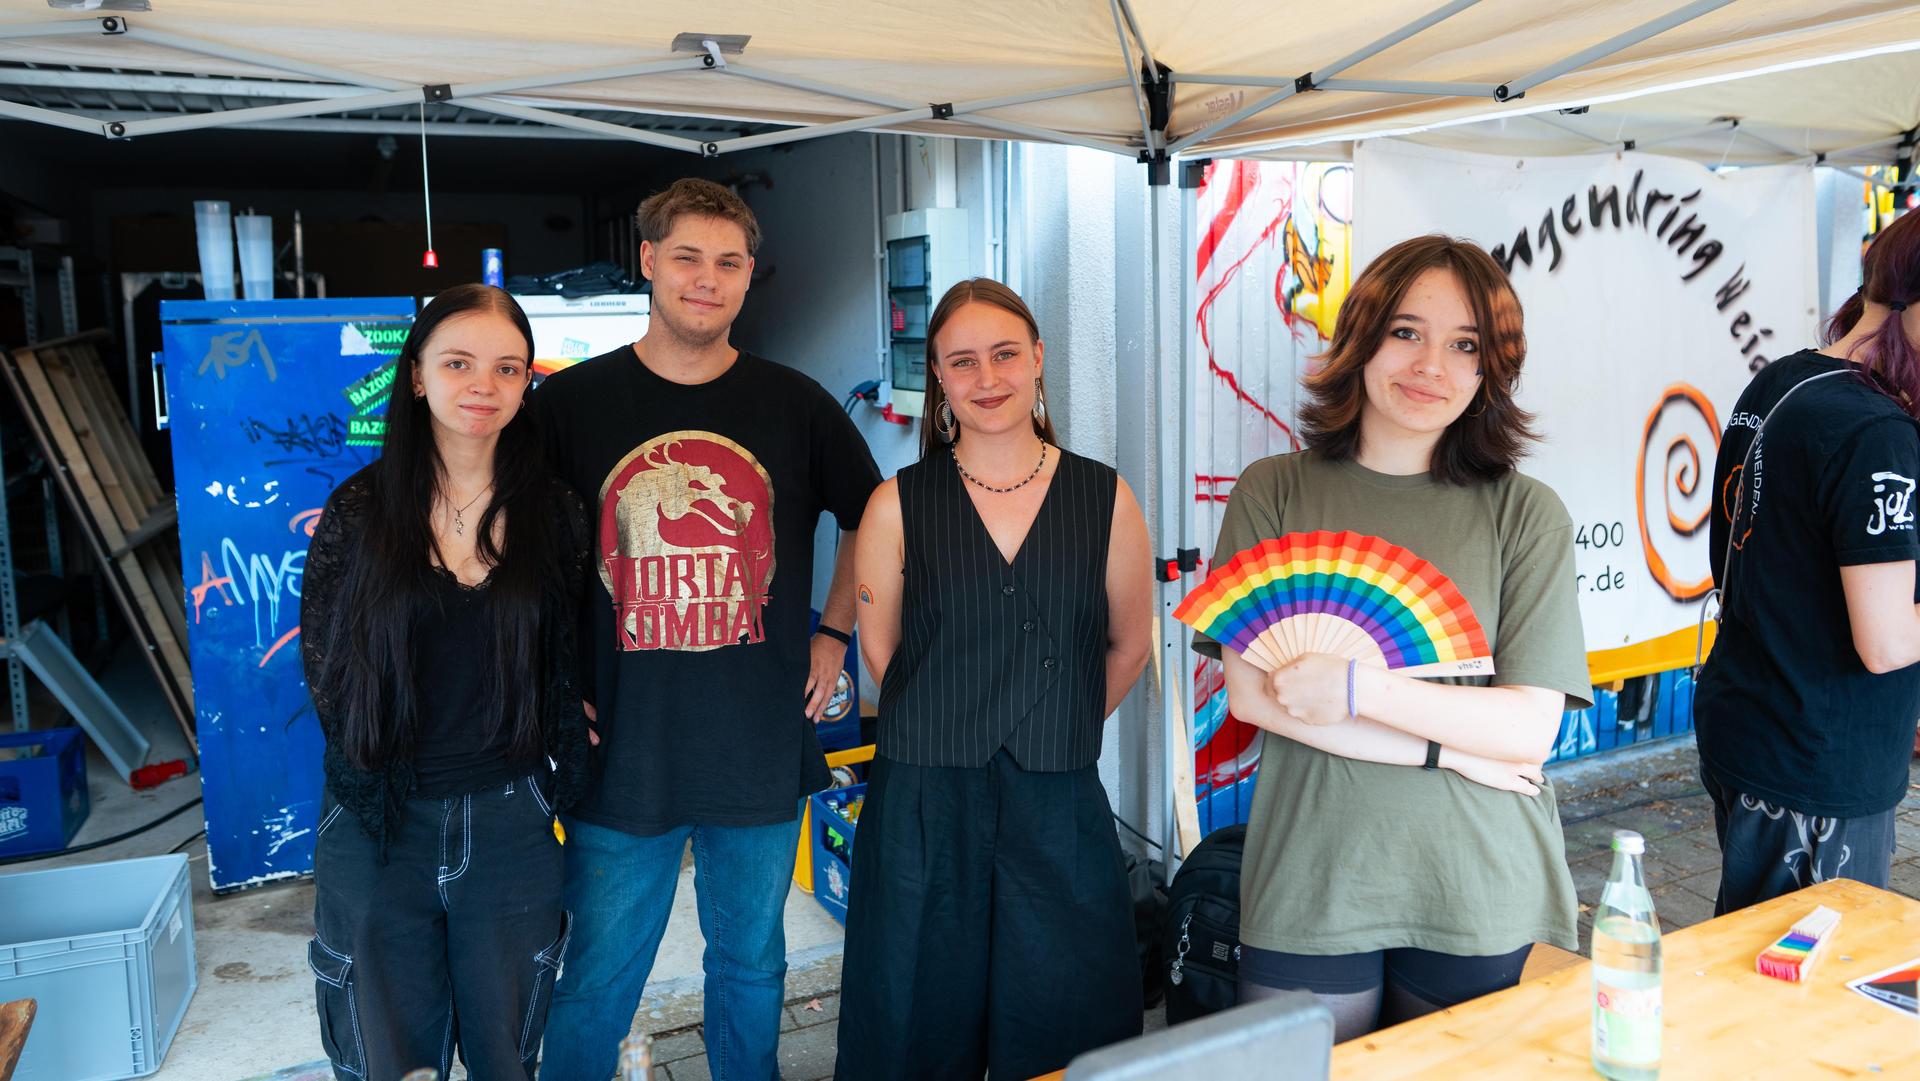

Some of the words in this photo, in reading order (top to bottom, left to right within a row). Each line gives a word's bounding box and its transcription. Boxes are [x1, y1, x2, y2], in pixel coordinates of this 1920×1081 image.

[1490, 168, 1724, 282] ugendring
[604, 552, 770, 601] MORTAL
[613, 598, 769, 651] KOMBAT
